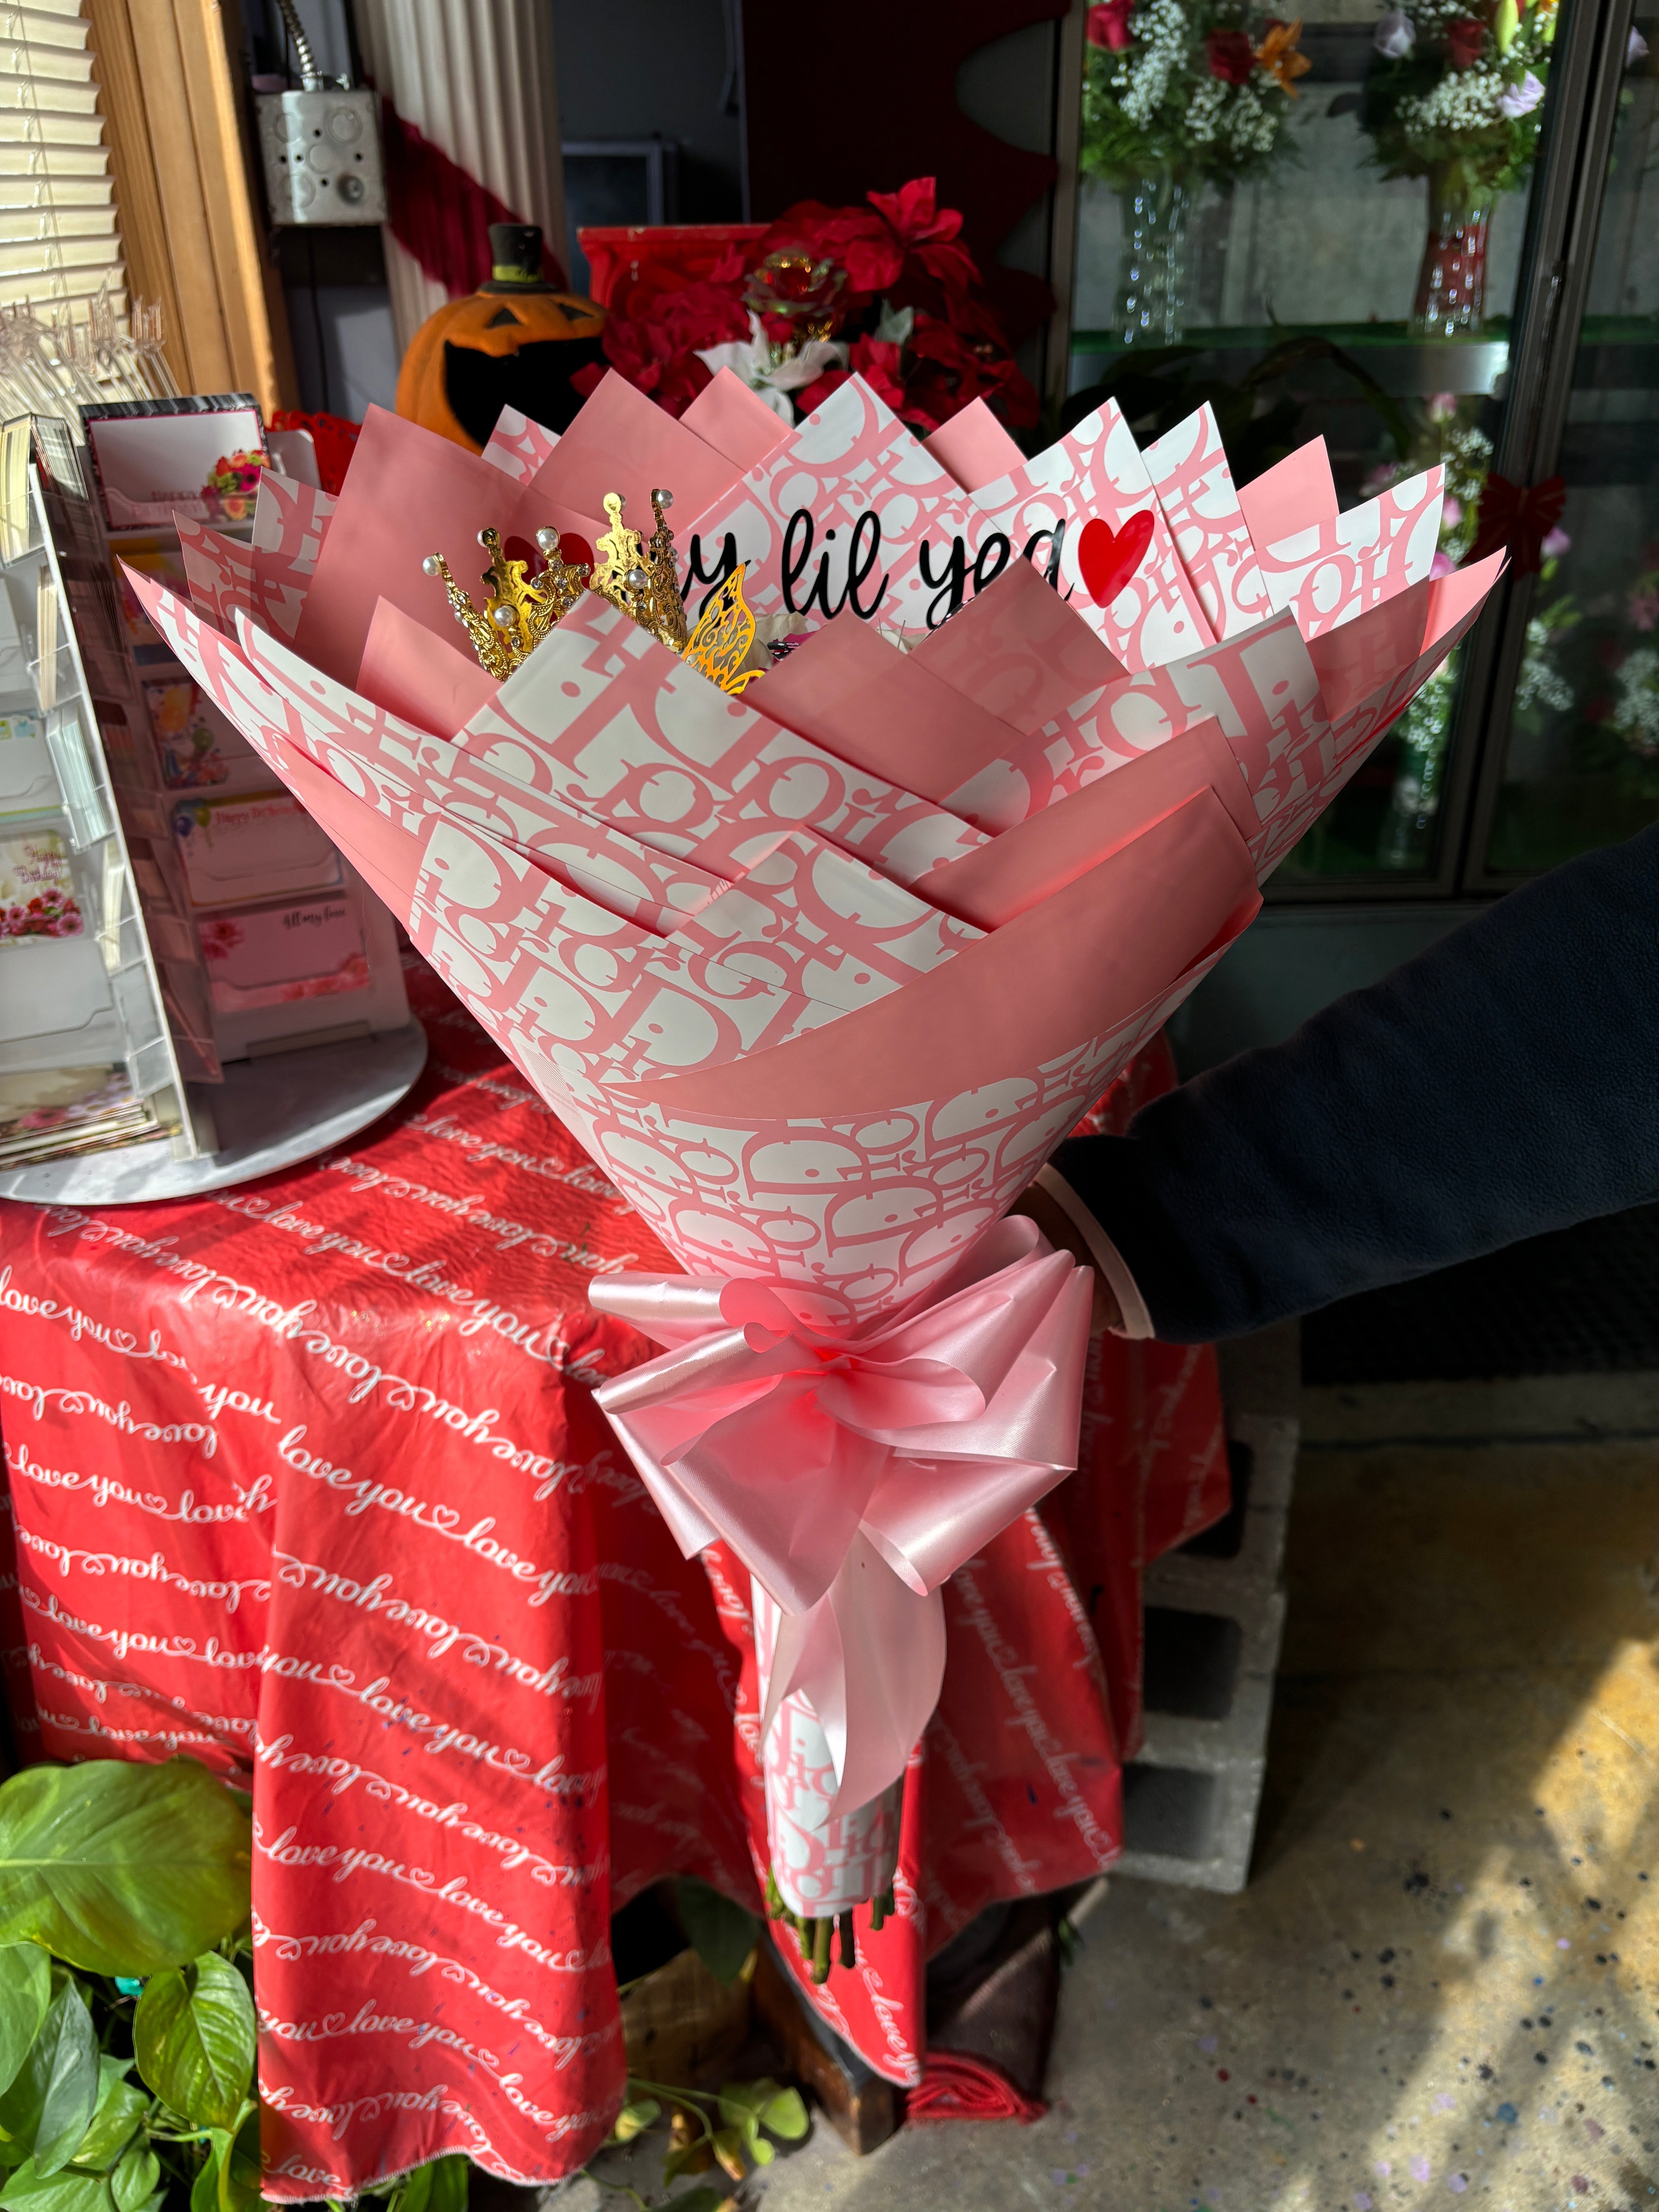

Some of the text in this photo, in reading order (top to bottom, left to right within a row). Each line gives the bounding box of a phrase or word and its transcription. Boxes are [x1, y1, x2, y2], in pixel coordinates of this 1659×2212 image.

[781, 508, 889, 620] lil
[13, 865, 59, 887] Birthday
[23, 845, 62, 868] Happy
[0, 1264, 58, 1319] love
[66, 1306, 112, 1341] you
[459, 1298, 541, 1353] you
[306, 1331, 383, 1403] love
[0, 1375, 218, 1459] love you lov
[420, 1389, 499, 1444] you
[17, 1443, 80, 1490] love
[88, 1474, 143, 1507] you
[198, 1383, 281, 1424] you
[278, 1424, 352, 1489] love
[345, 1479, 428, 1519] you
[463, 1516, 536, 1581] love
[492, 1437, 565, 1501] love
[112, 1552, 170, 1582] you
[175, 1578, 241, 1614] love
[310, 1567, 393, 1611] you
[49, 1593, 102, 1640] love
[112, 1628, 169, 1659] you
[386, 1599, 460, 1658] love
[360, 1676, 432, 1731] love
[424, 1724, 501, 1761] you
[288, 1753, 360, 1795] love
[267, 1826, 336, 1865] love
[334, 1848, 405, 1882] you
[438, 1876, 503, 1923] love
[496, 1923, 564, 1970] you
[307, 1918, 377, 1956] you
[371, 1936, 438, 1976] love
[349, 1998, 414, 2033] love
[409, 2022, 476, 2058] you
[385, 2084, 448, 2112] you
